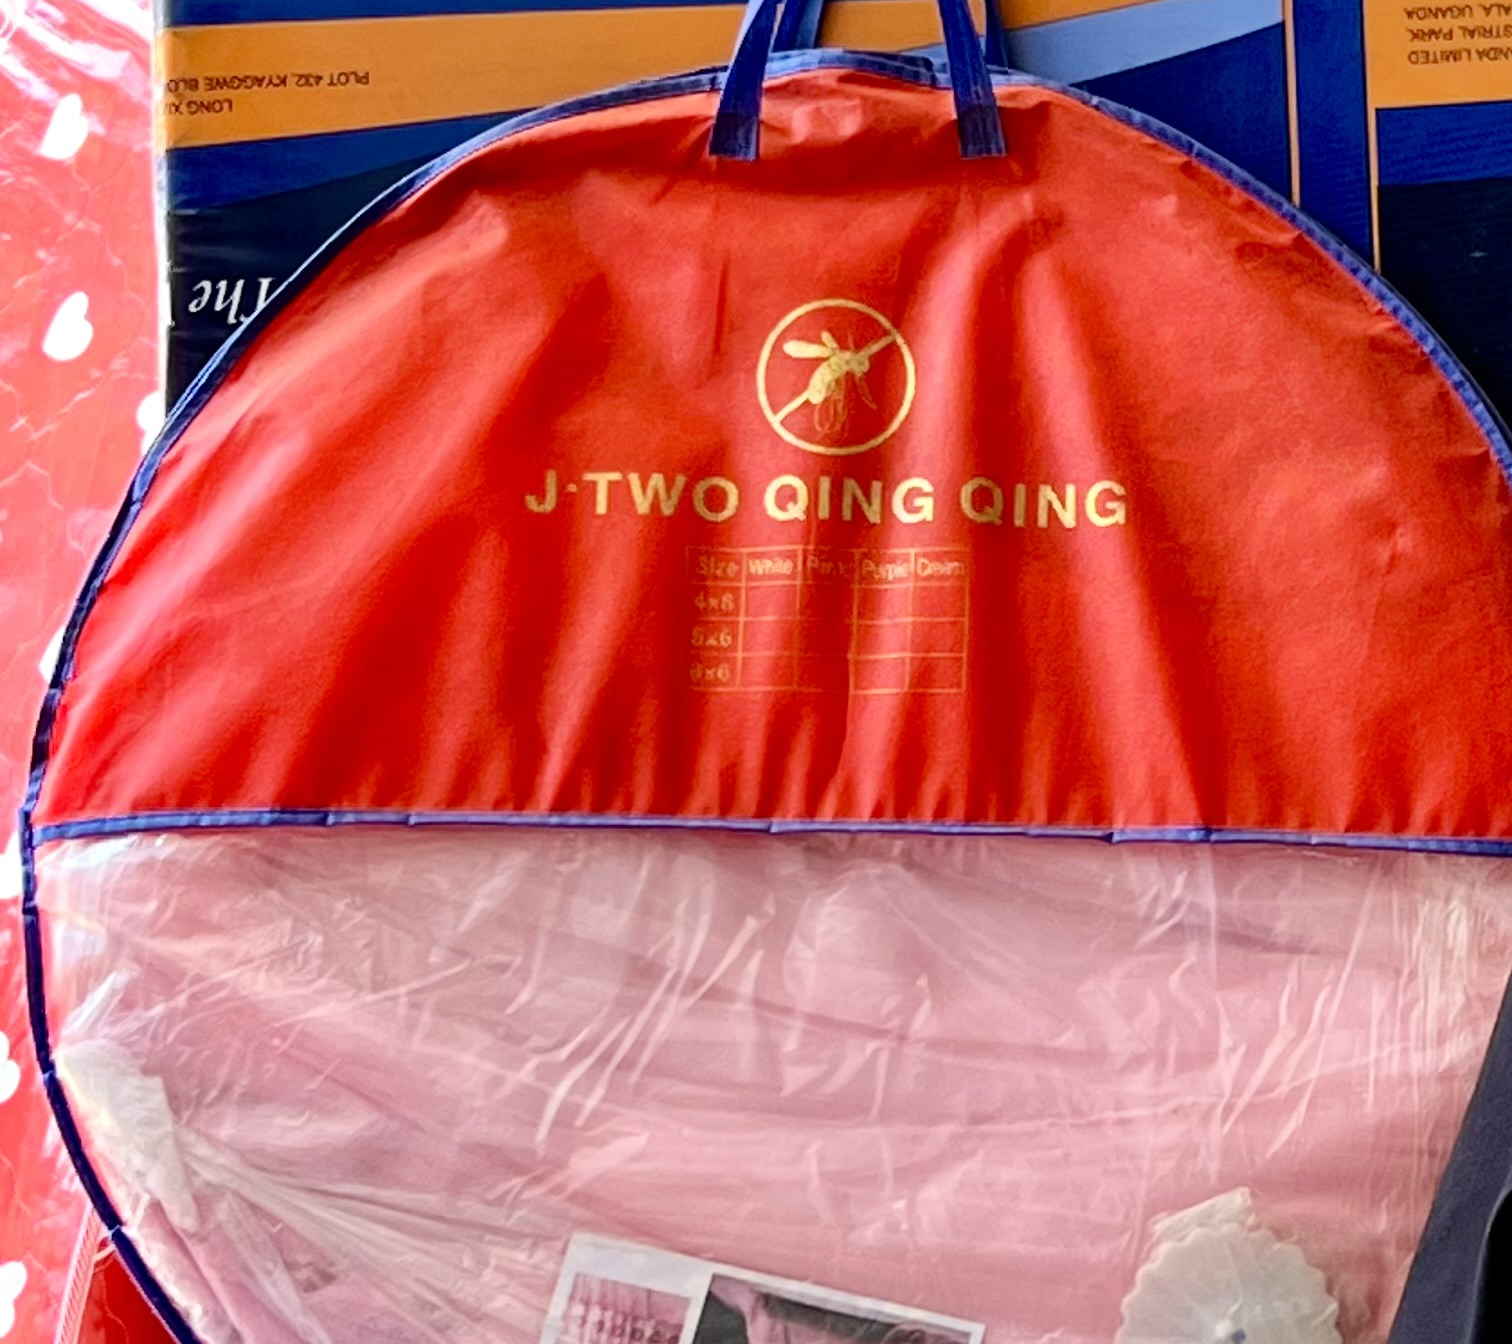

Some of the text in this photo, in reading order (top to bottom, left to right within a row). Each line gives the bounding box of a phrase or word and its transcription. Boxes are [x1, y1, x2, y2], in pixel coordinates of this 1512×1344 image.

[1404, 6, 1473, 20] UGANDA
[1407, 49, 1470, 66] LIMITED
[326, 71, 370, 87] PLOT
[186, 98, 233, 116] LONG
[187, 276, 277, 325] The
[763, 474, 935, 526] QING
[958, 477, 1128, 529] QING
